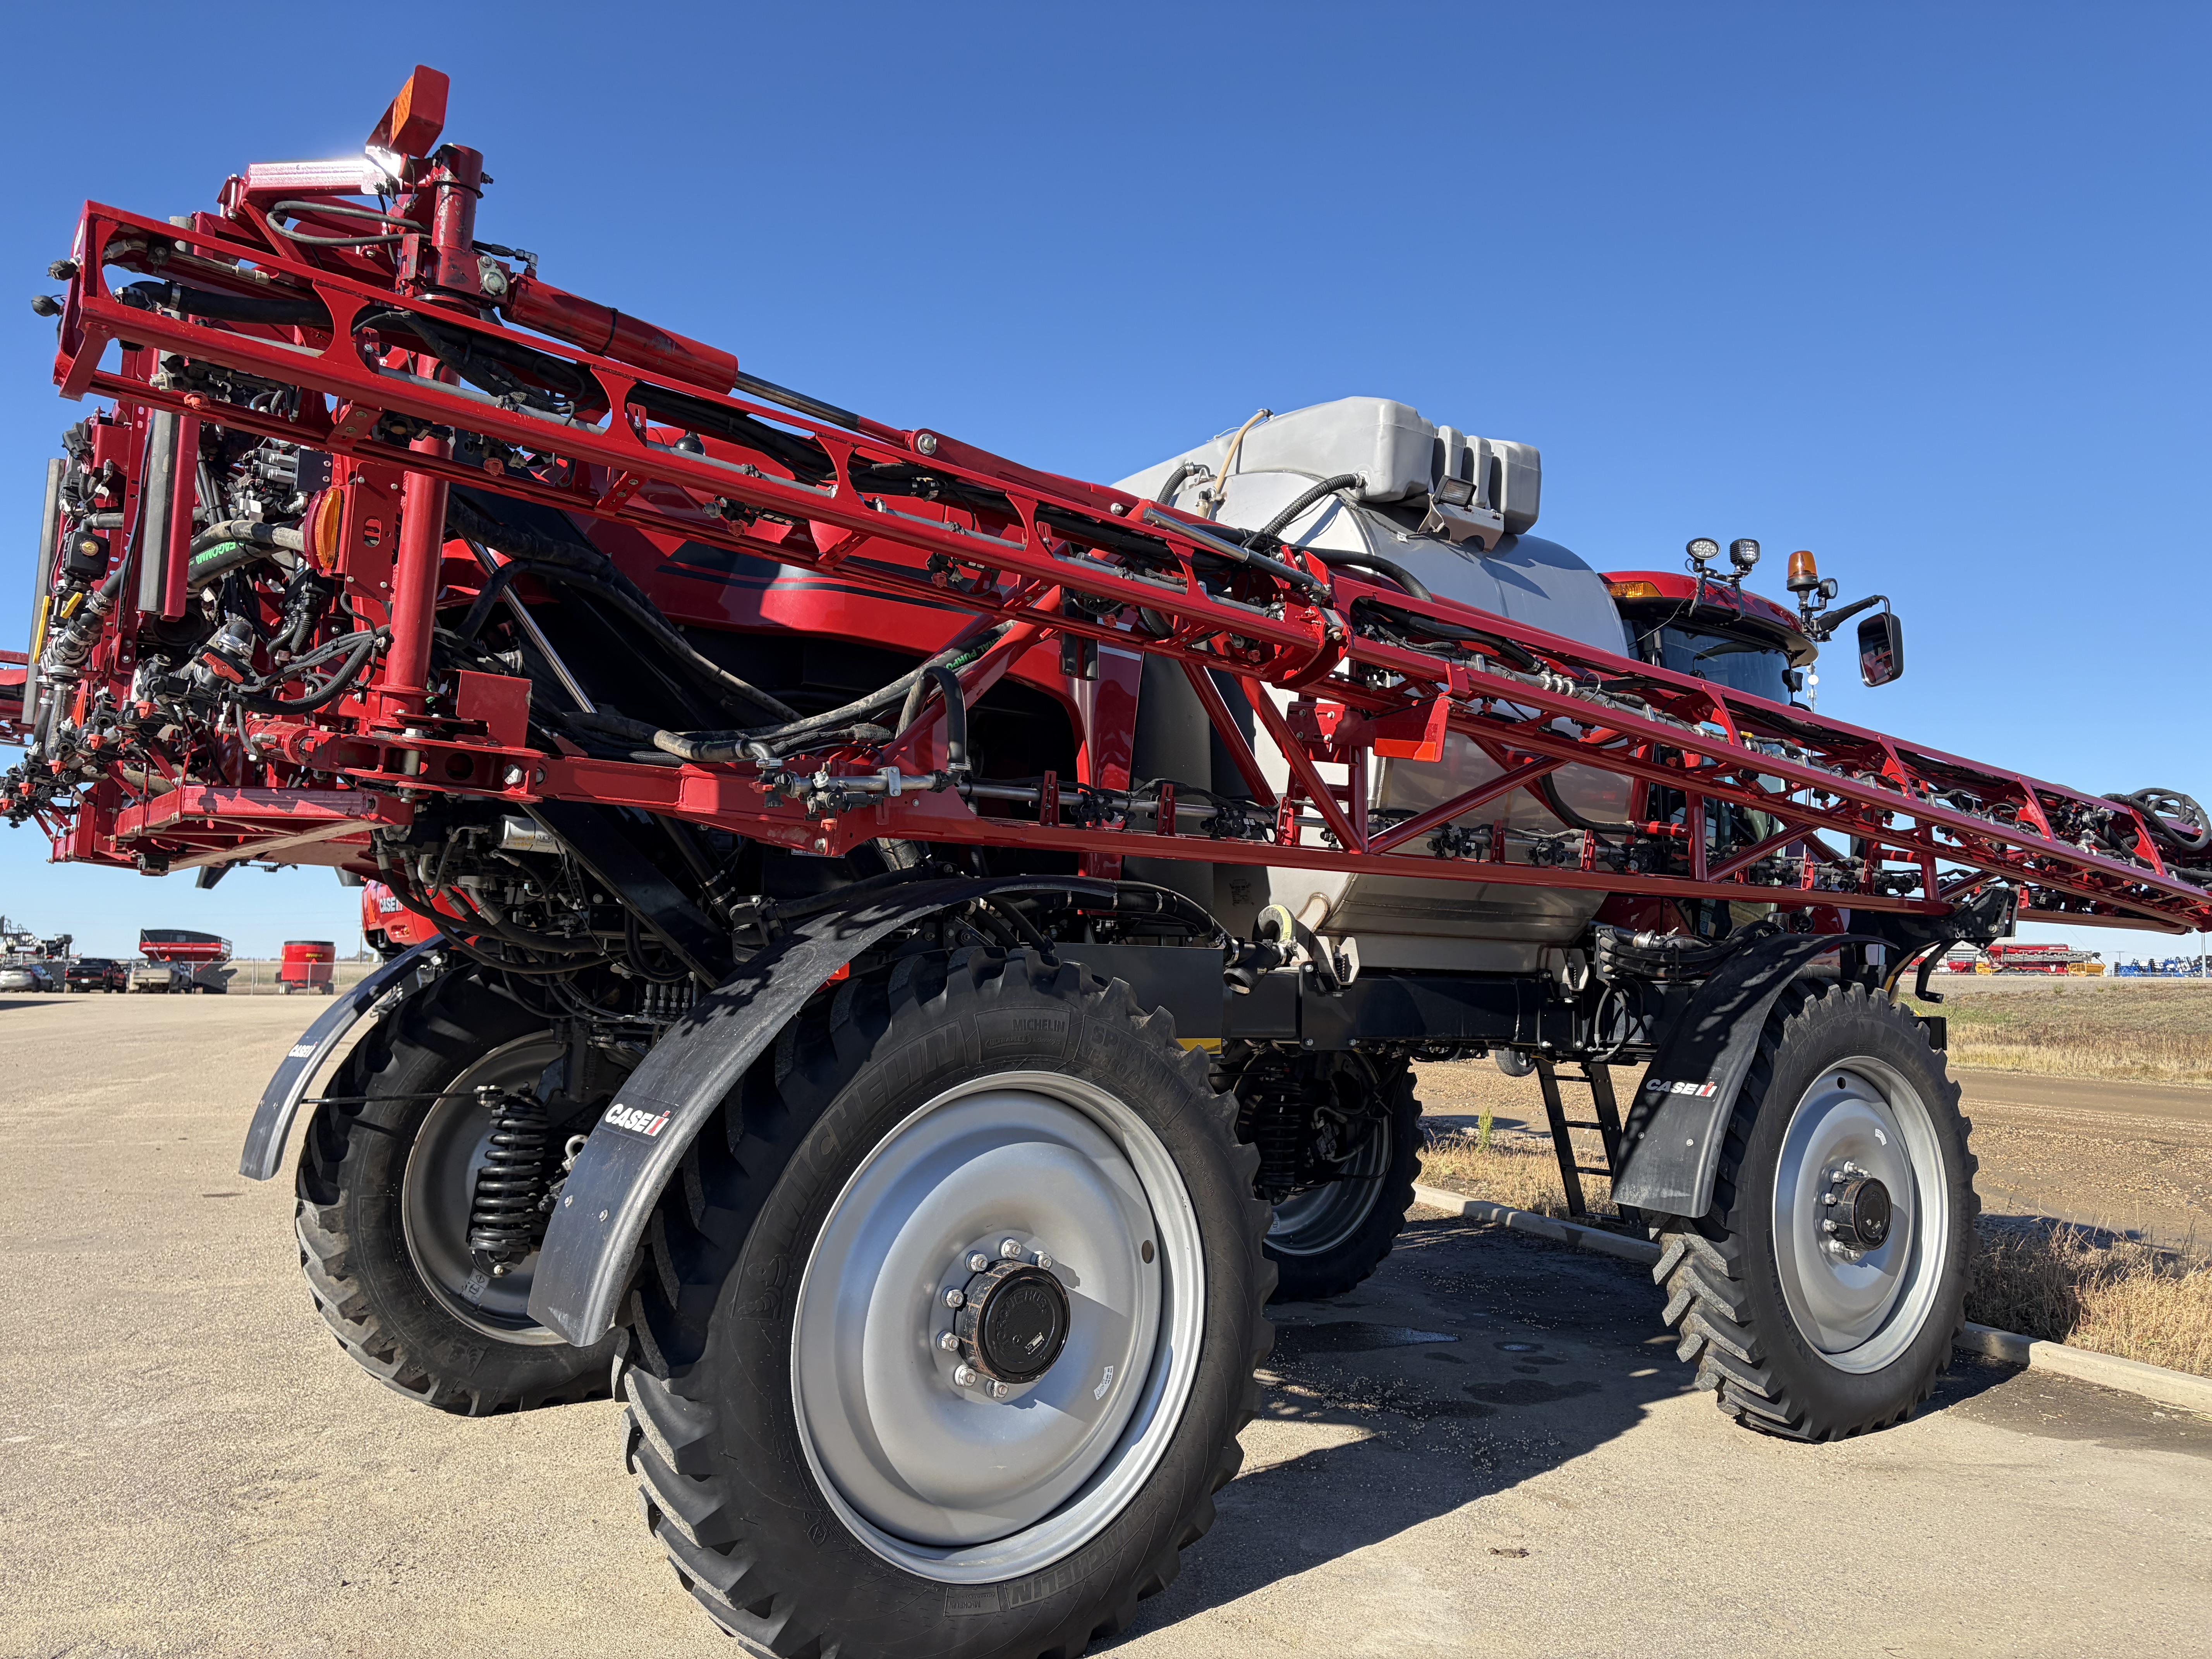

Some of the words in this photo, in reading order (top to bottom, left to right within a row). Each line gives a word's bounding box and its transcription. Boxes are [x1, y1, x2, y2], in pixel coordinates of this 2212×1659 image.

[379, 896, 396, 913] CASE
[1012, 1019, 1065, 1033] MICHELIN
[1080, 1045, 1101, 1062] VF
[1091, 1025, 1180, 1099] SPRAYBIB
[1646, 1079, 1699, 1095] CASE
[605, 1103, 654, 1132] CASE
[764, 1026, 958, 1247] MICHELIN
[1012, 1515, 1135, 1604] MICHELIN
[949, 1599, 981, 1609] MICHELIN
